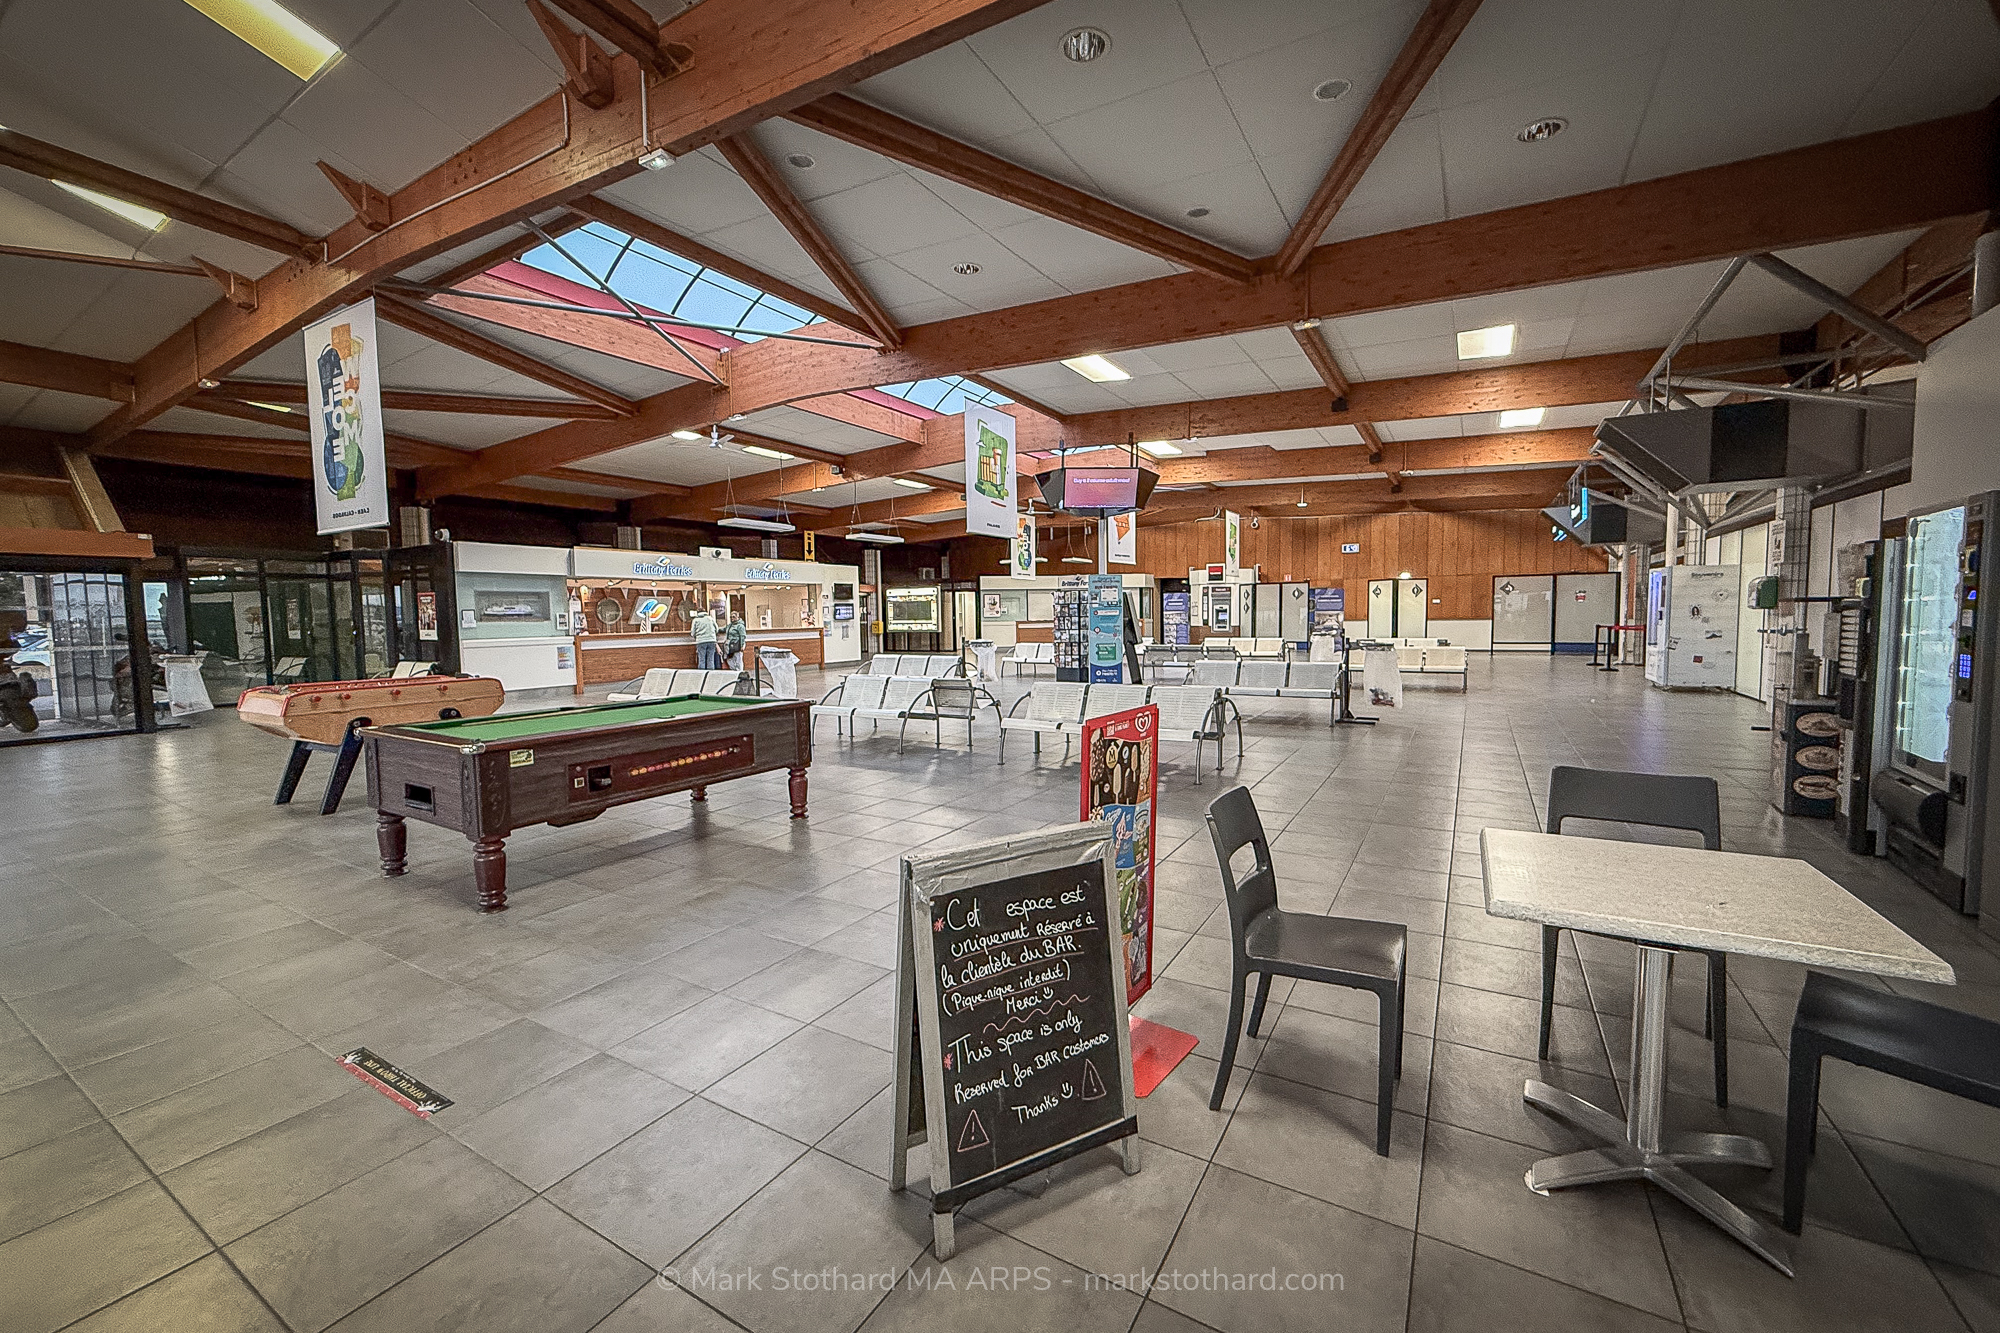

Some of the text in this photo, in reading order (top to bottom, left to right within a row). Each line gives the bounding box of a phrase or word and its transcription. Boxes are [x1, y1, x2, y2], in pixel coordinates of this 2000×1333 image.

[633, 562, 693, 577] Brittany Ferries
[745, 568, 791, 580] Brittany Ferries
[1061, 580, 1080, 588] Brittany
[947, 884, 1086, 931] Cet espace est
[1085, 912, 1096, 925] à
[941, 964, 957, 989] la
[961, 951, 1017, 985] clientèle
[1020, 944, 1043, 963] du
[1006, 995, 1042, 1015] Merci
[948, 1009, 1083, 1074] This space is only
[954, 1070, 1010, 1105] Reserved
[1013, 1062, 1034, 1088] for
[1034, 1049, 1061, 1071] BAR
[1011, 1095, 1059, 1125] Thanks
